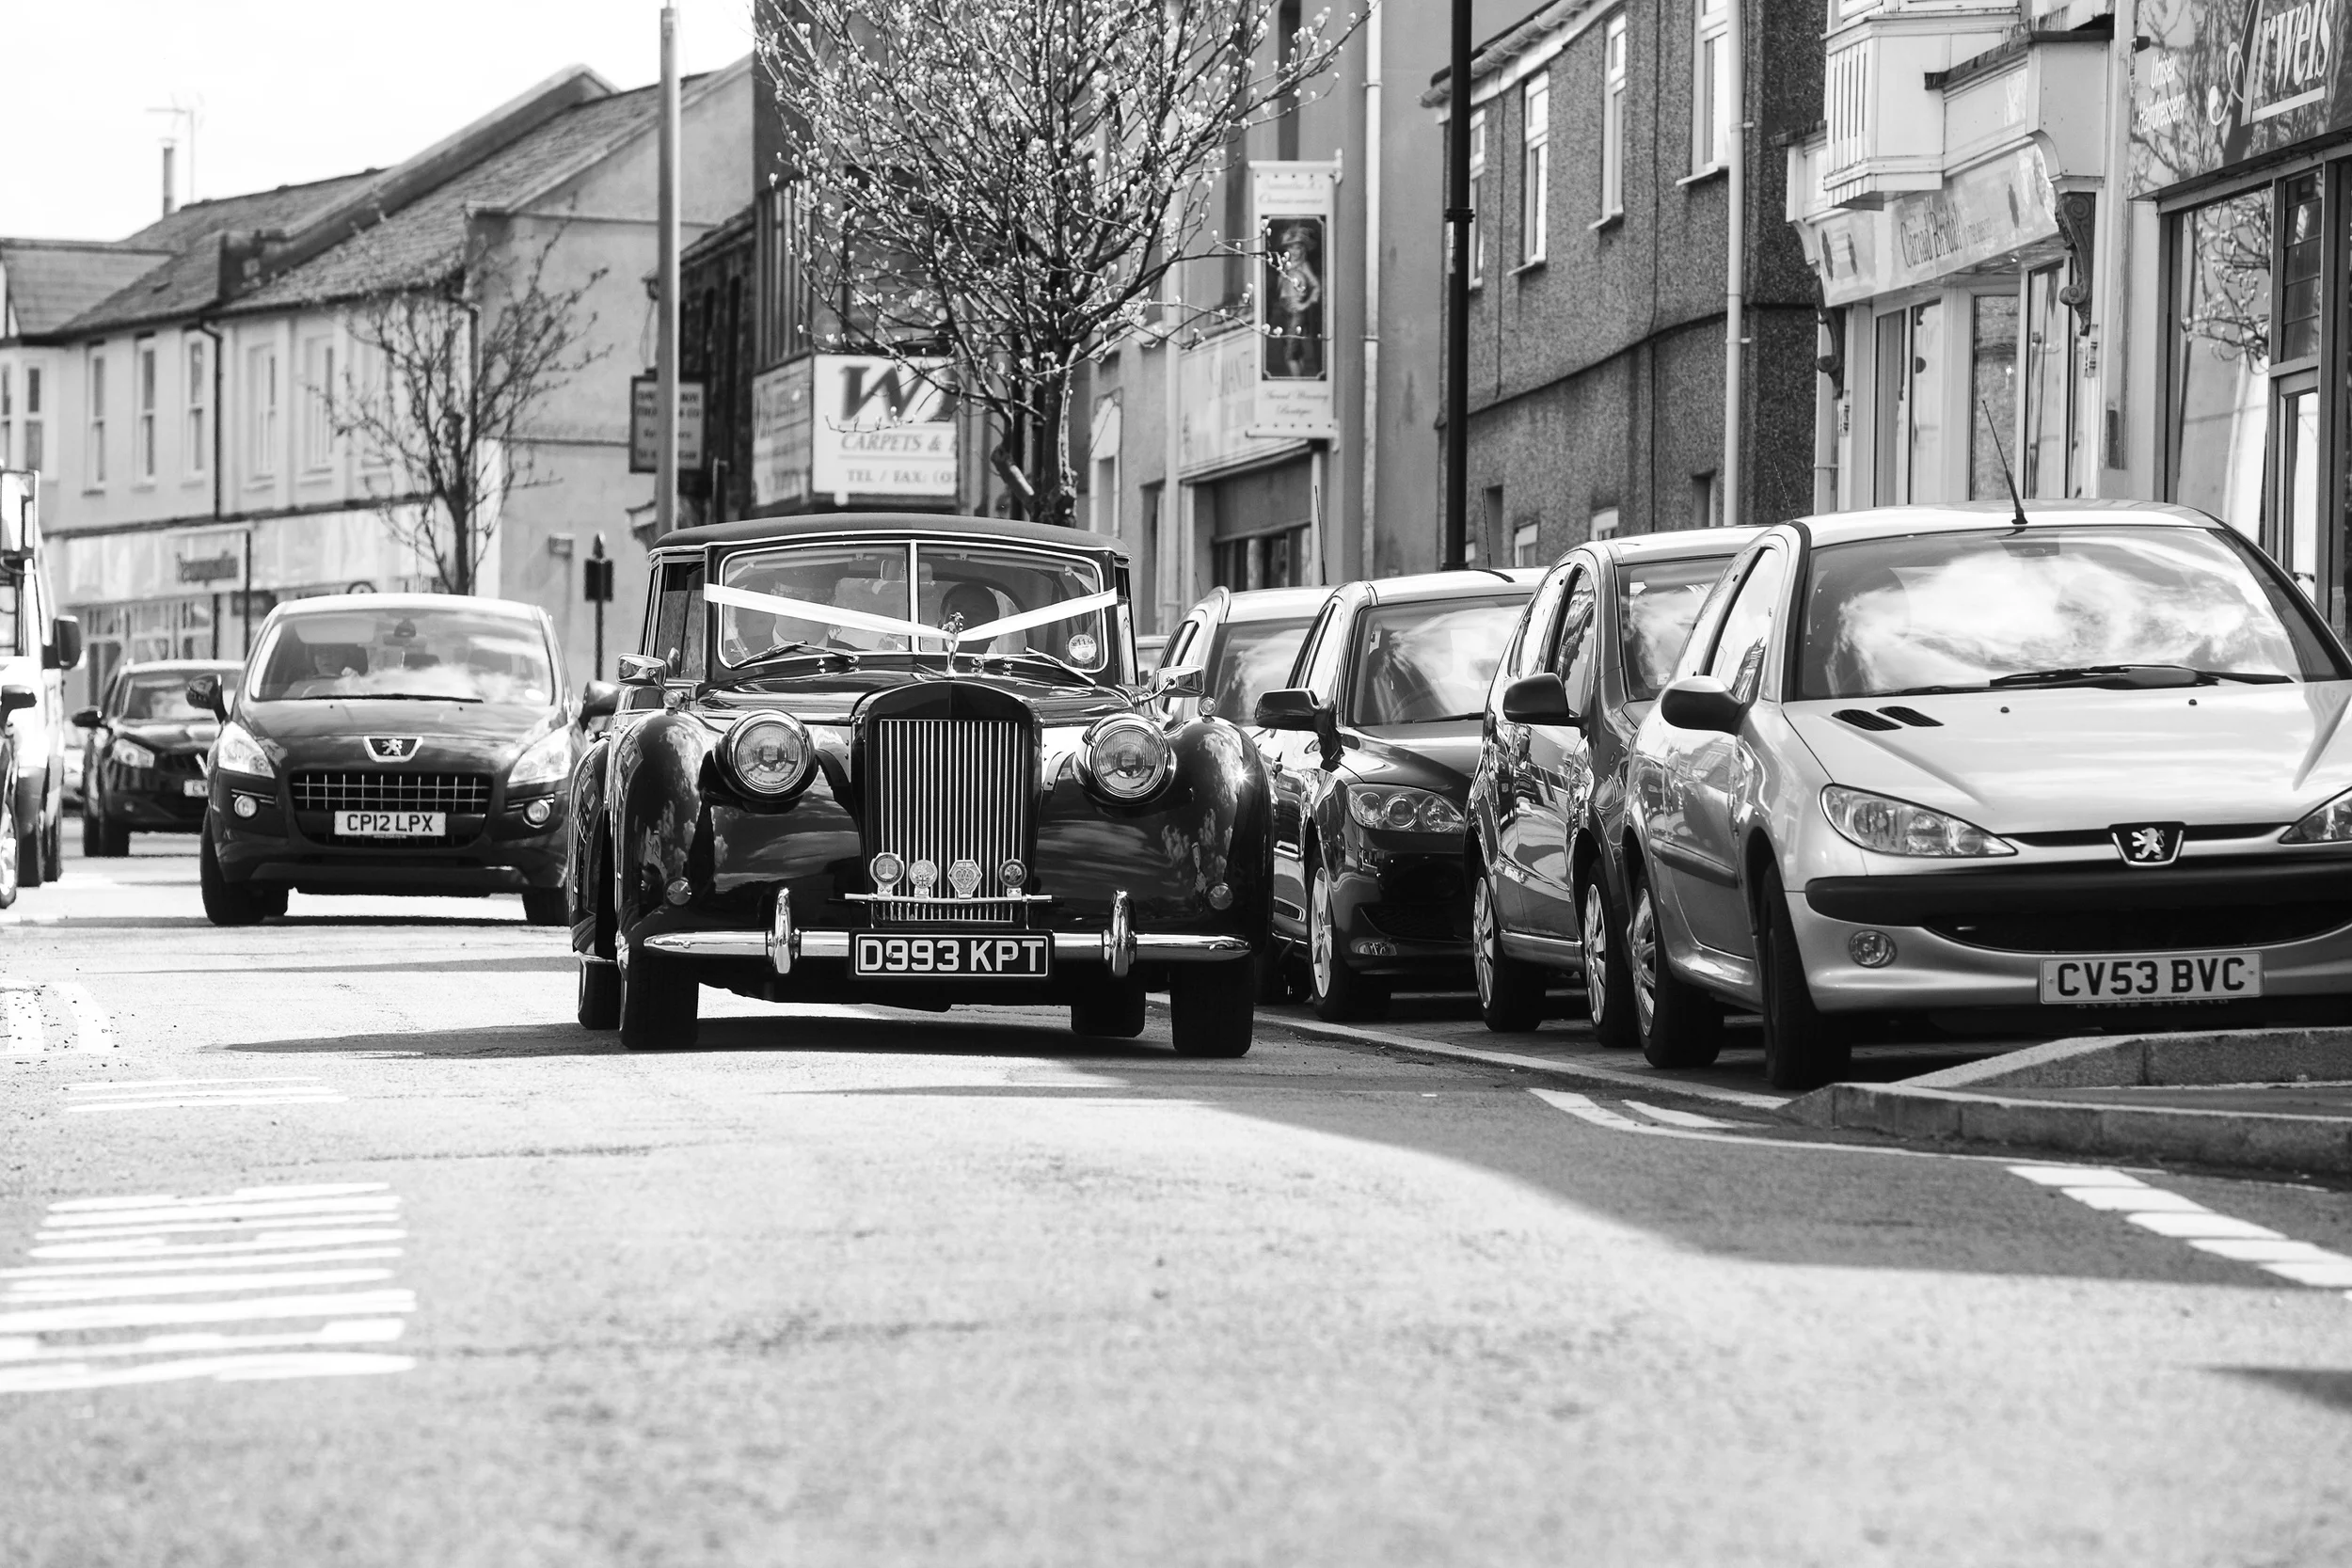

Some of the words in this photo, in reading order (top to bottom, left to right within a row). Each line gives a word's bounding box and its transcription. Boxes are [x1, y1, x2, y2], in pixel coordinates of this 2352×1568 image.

[2151, 52, 2177, 89] Unisex
[2209, 0, 2334, 126] Arwels
[2137, 92, 2185, 135] Hairdressers
[1929, 201, 1963, 259] Bridal
[840, 434, 921, 451] CARPETS
[928, 435, 941, 451] &
[848, 470, 873, 483] TEL
[346, 814, 390, 832] CP12
[395, 814, 433, 832] LPX
[860, 940, 960, 971] D993
[970, 940, 1044, 972] KPT
[2058, 960, 2158, 996] CV53
[2170, 957, 2245, 993] BVC
